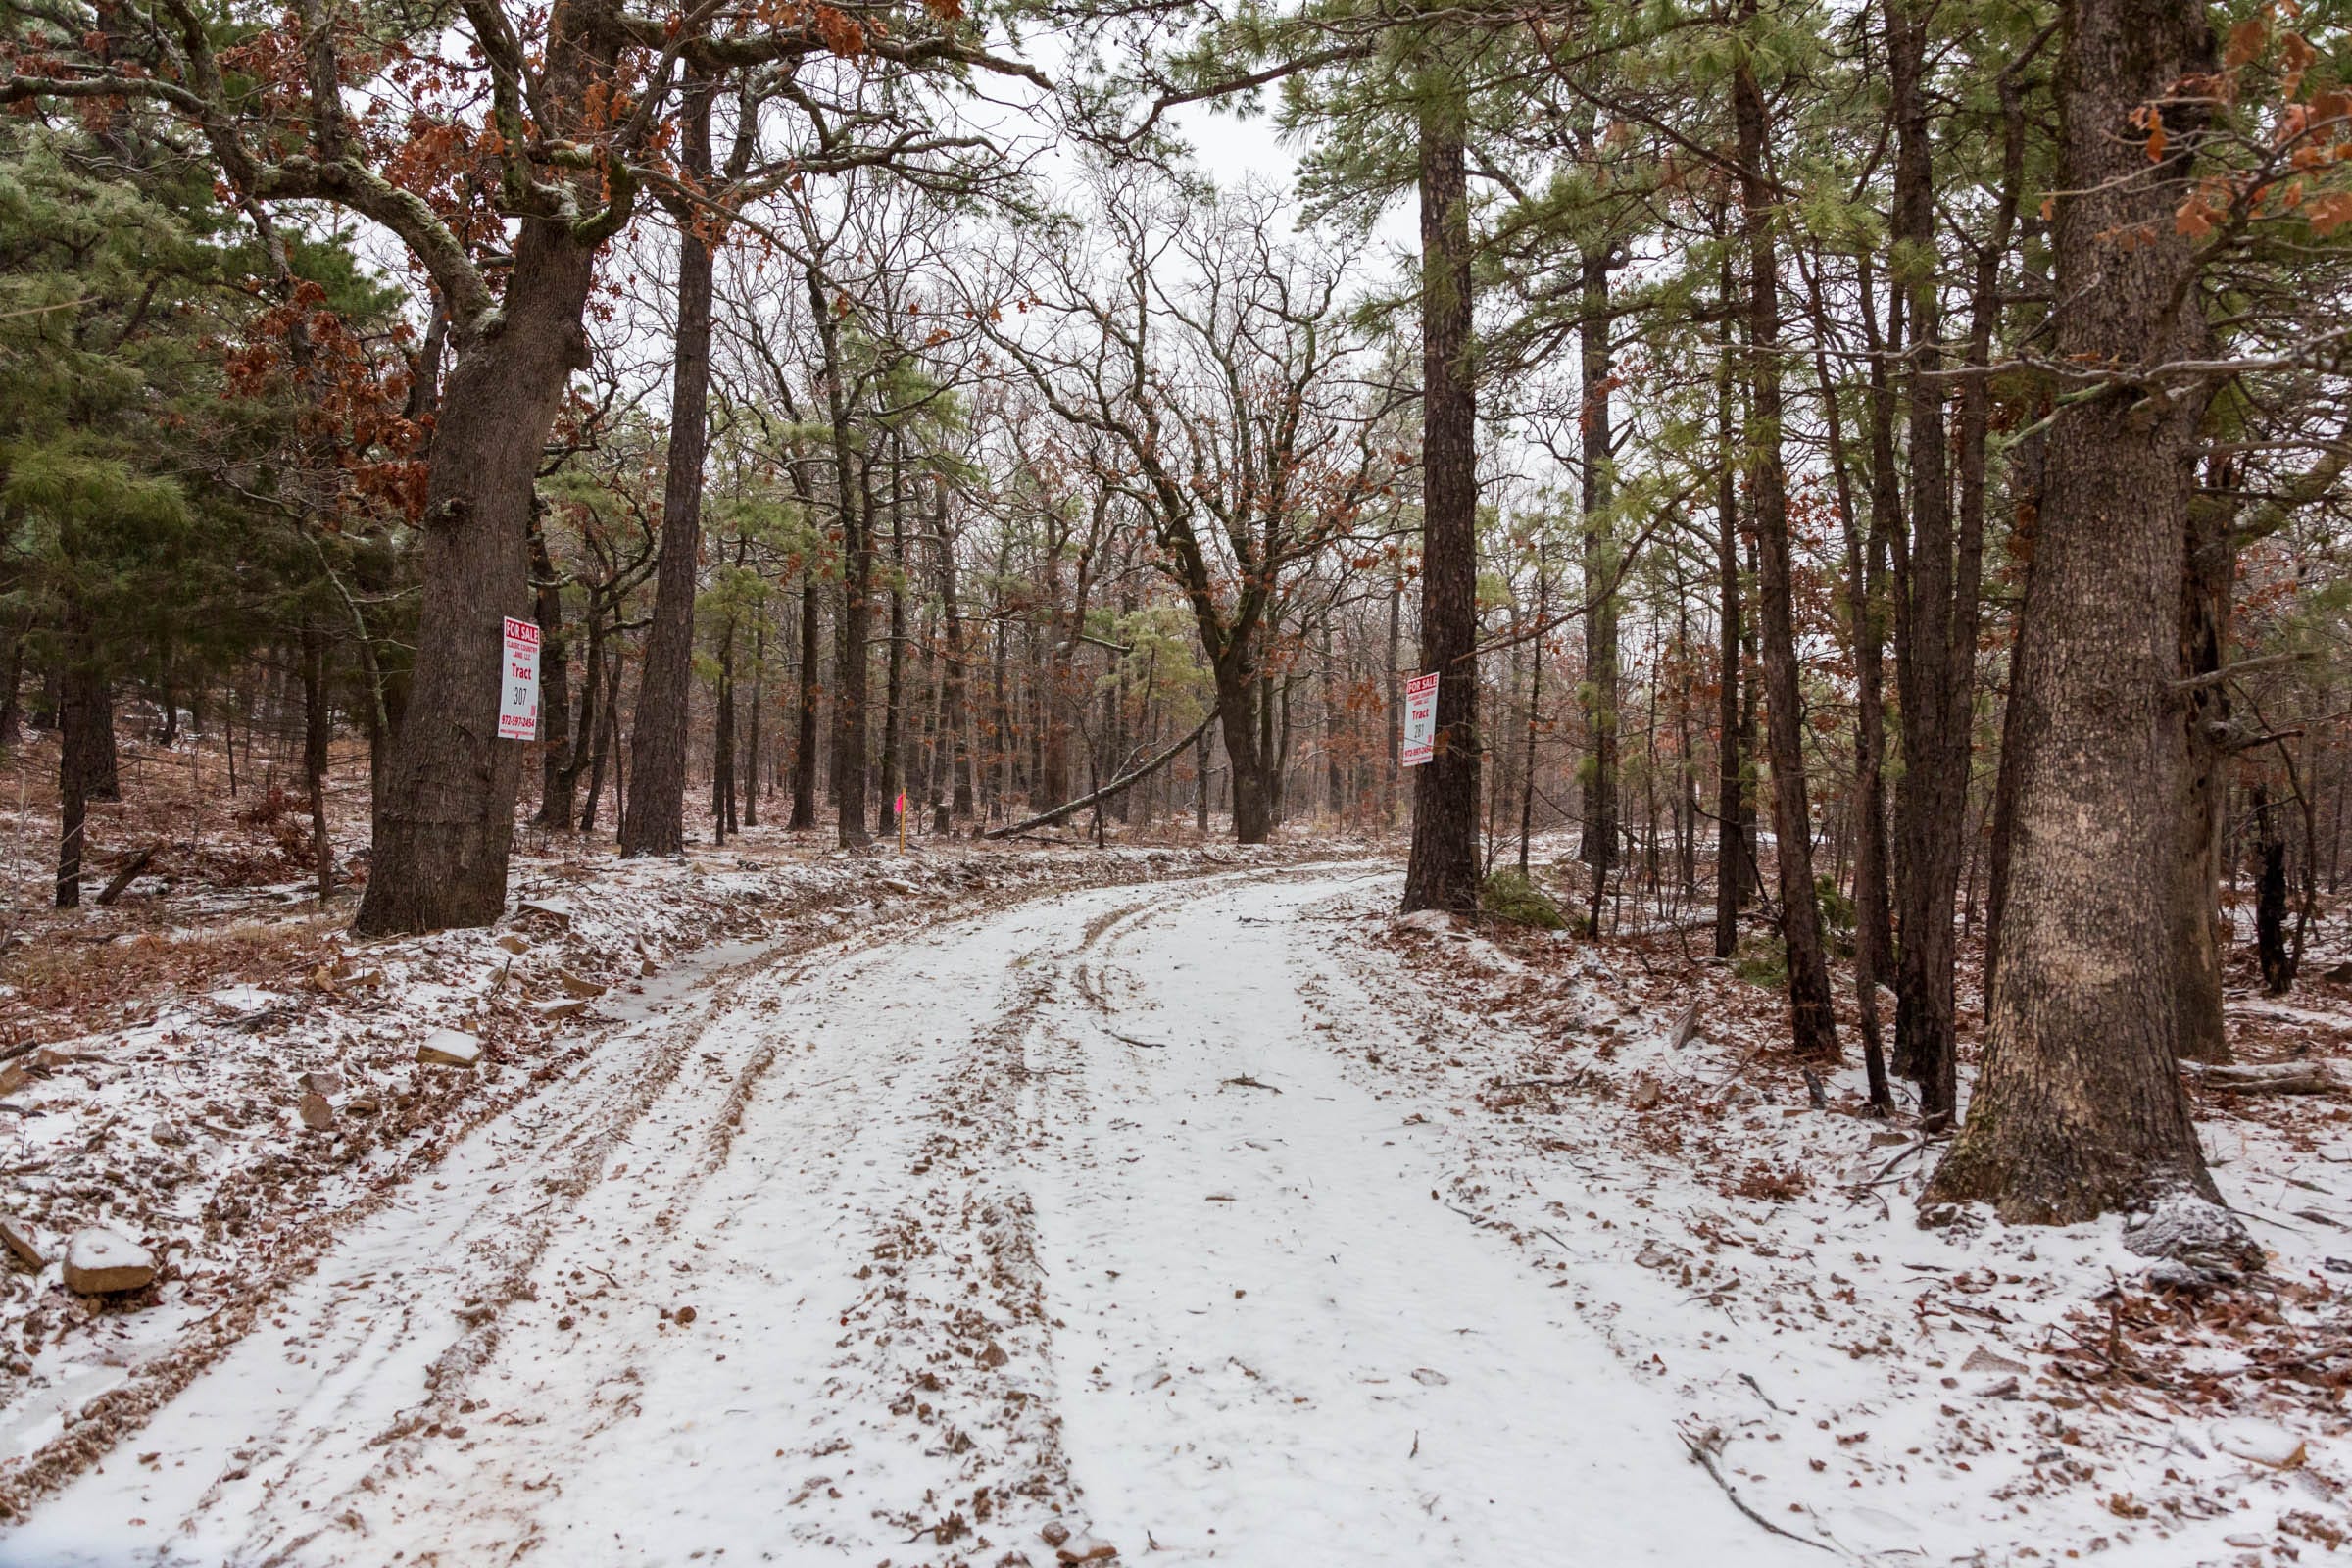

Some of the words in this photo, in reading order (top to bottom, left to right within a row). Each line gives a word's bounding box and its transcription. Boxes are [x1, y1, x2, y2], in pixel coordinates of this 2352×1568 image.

[506, 621, 520, 638] FOR
[520, 626, 538, 643] SALE
[512, 662, 532, 680] Tract
[1408, 680, 1421, 693] FOR
[1422, 675, 1437, 689] SALE
[514, 686, 527, 706] 307
[501, 714, 535, 727] 972-597-2454
[1412, 708, 1429, 720] Tract
